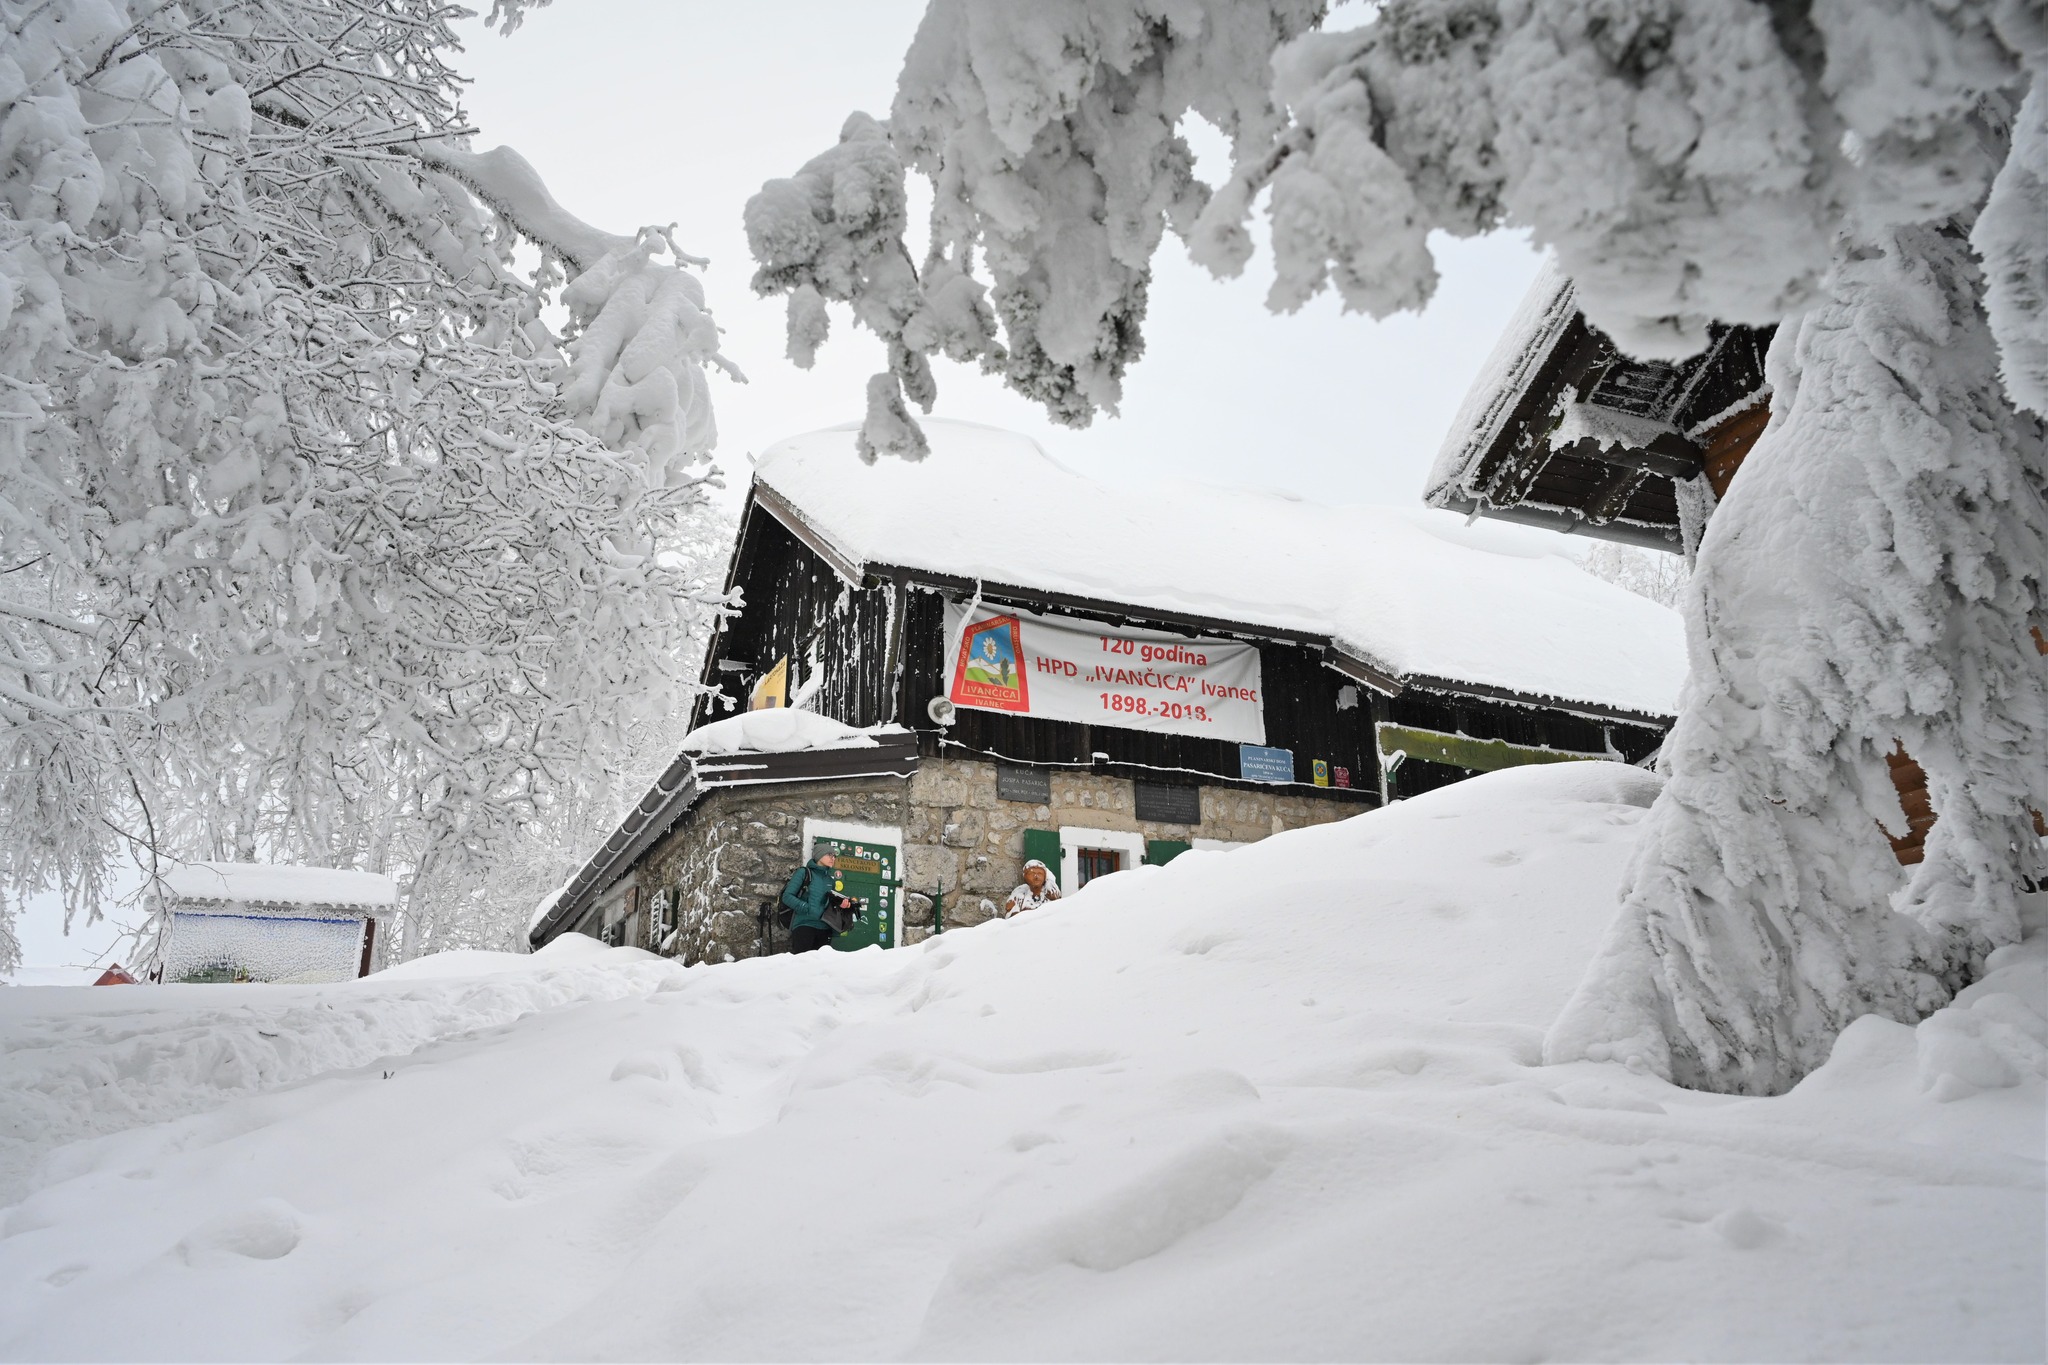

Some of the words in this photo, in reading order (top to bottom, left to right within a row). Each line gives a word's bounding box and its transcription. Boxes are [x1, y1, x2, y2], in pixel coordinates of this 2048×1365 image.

[1099, 636, 1134, 656] 120
[1140, 644, 1208, 667] godina
[967, 685, 1017, 699] IVANČICA
[1036, 656, 1078, 677] HPD
[1201, 679, 1258, 703] Ivanec
[975, 698, 1005, 709] IVANEC
[1100, 692, 1213, 723] 1898.-2018.
